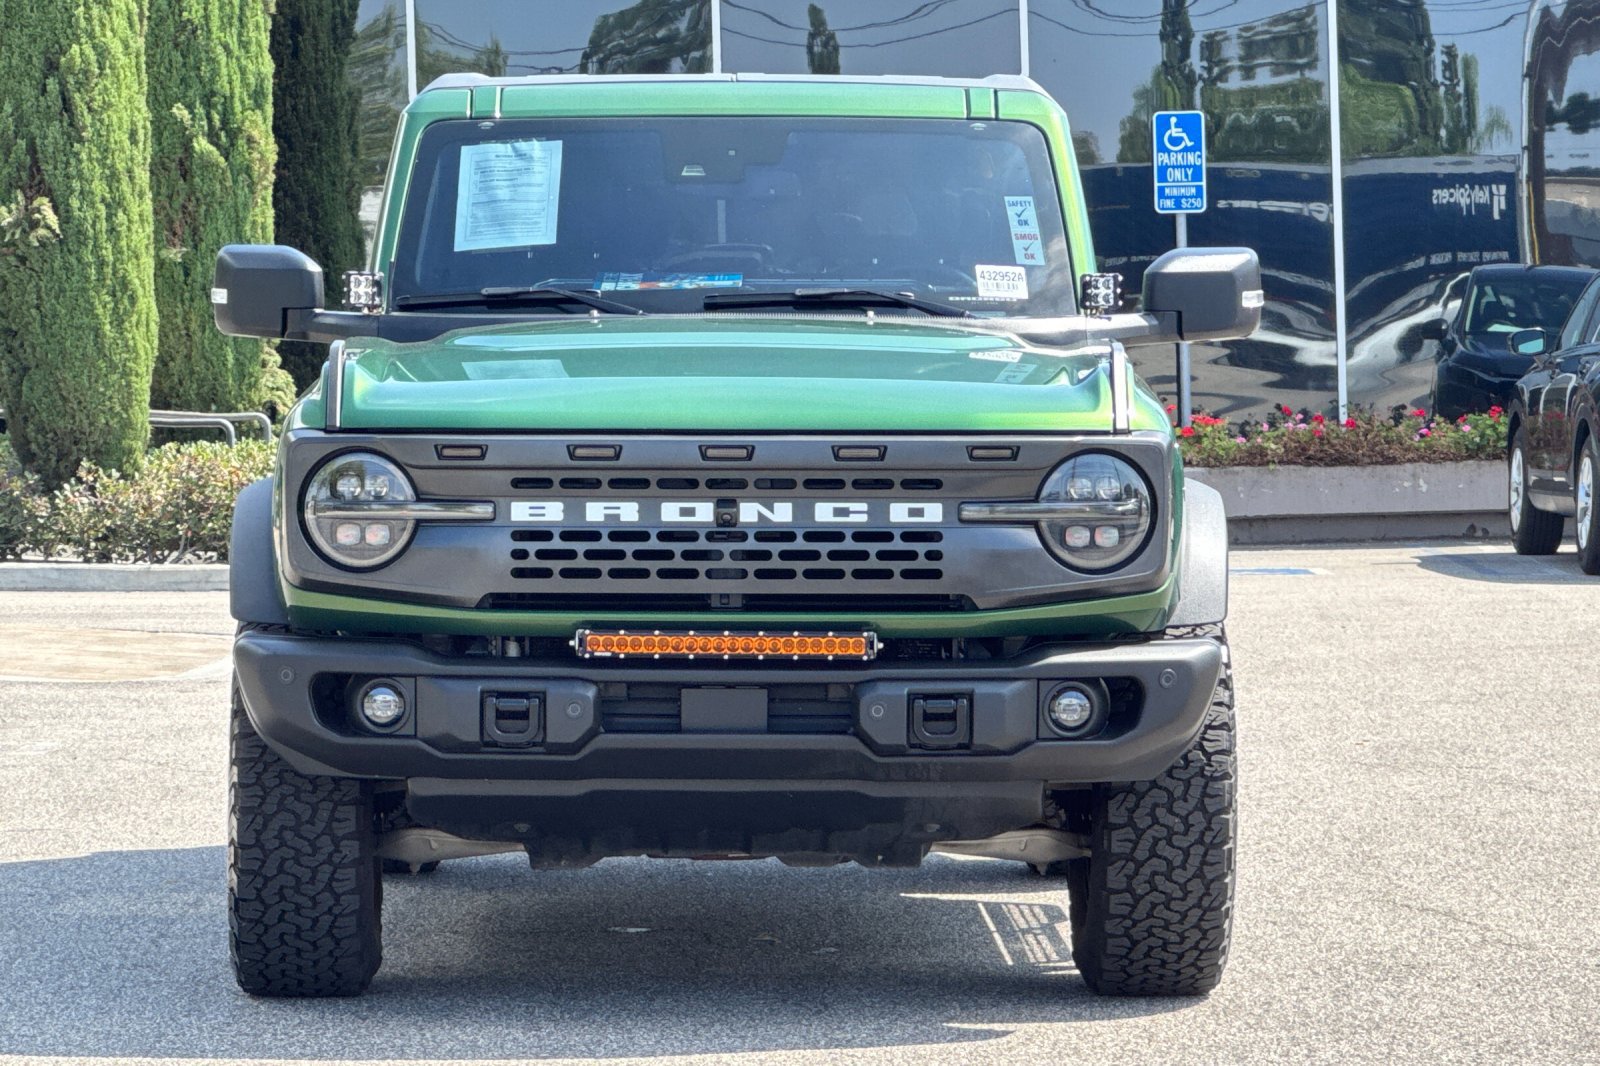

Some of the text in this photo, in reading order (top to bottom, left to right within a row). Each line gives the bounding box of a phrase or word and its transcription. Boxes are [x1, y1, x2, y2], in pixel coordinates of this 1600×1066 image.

[1158, 152, 1202, 166] PARKING
[1167, 167, 1193, 182] ONLY
[1165, 187, 1196, 197] MINIMUM
[1160, 198, 1202, 208] FINE $250
[980, 270, 1024, 282] 432952A
[510, 501, 943, 523] BRONCO
